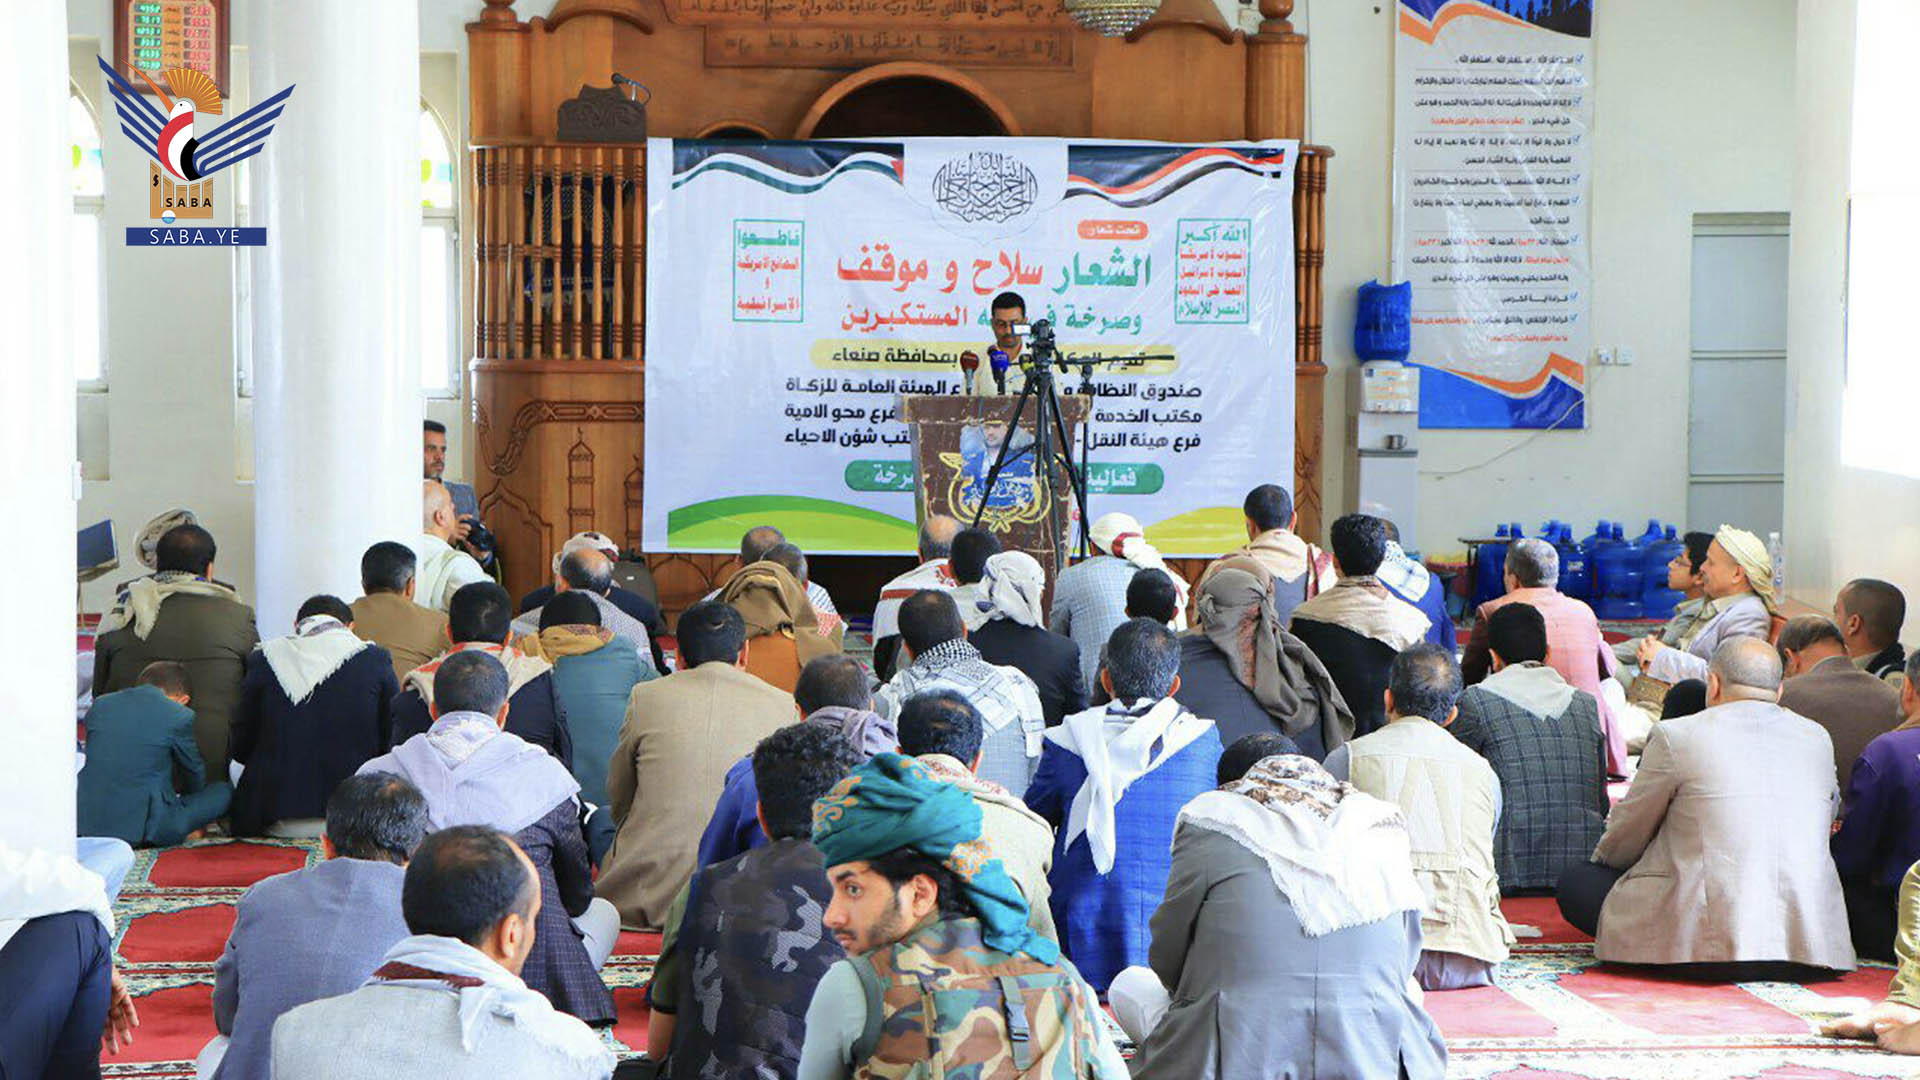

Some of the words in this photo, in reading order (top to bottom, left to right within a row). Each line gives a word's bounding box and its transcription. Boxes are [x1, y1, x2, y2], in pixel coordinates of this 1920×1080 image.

[837, 243, 928, 293] موقف
[939, 259, 959, 293] و
[972, 249, 1043, 295] سلاح
[1052, 246, 1151, 294] الشعار
[841, 303, 968, 331] المستكبرين
[1064, 303, 1142, 335] وصرخة
[832, 347, 880, 363] صنعاء
[884, 347, 957, 368] بمحافظة
[786, 376, 838, 397] للزكاة
[842, 378, 896, 395] العامة
[1140, 383, 1202, 400] صندوق
[832, 408, 866, 423] محو
[1095, 408, 1149, 424] الخدمة
[1152, 408, 1202, 426] مكتب
[1087, 432, 1127, 451] النقل
[1130, 434, 1170, 450] هيئة
[1172, 433, 1201, 453] فرع
